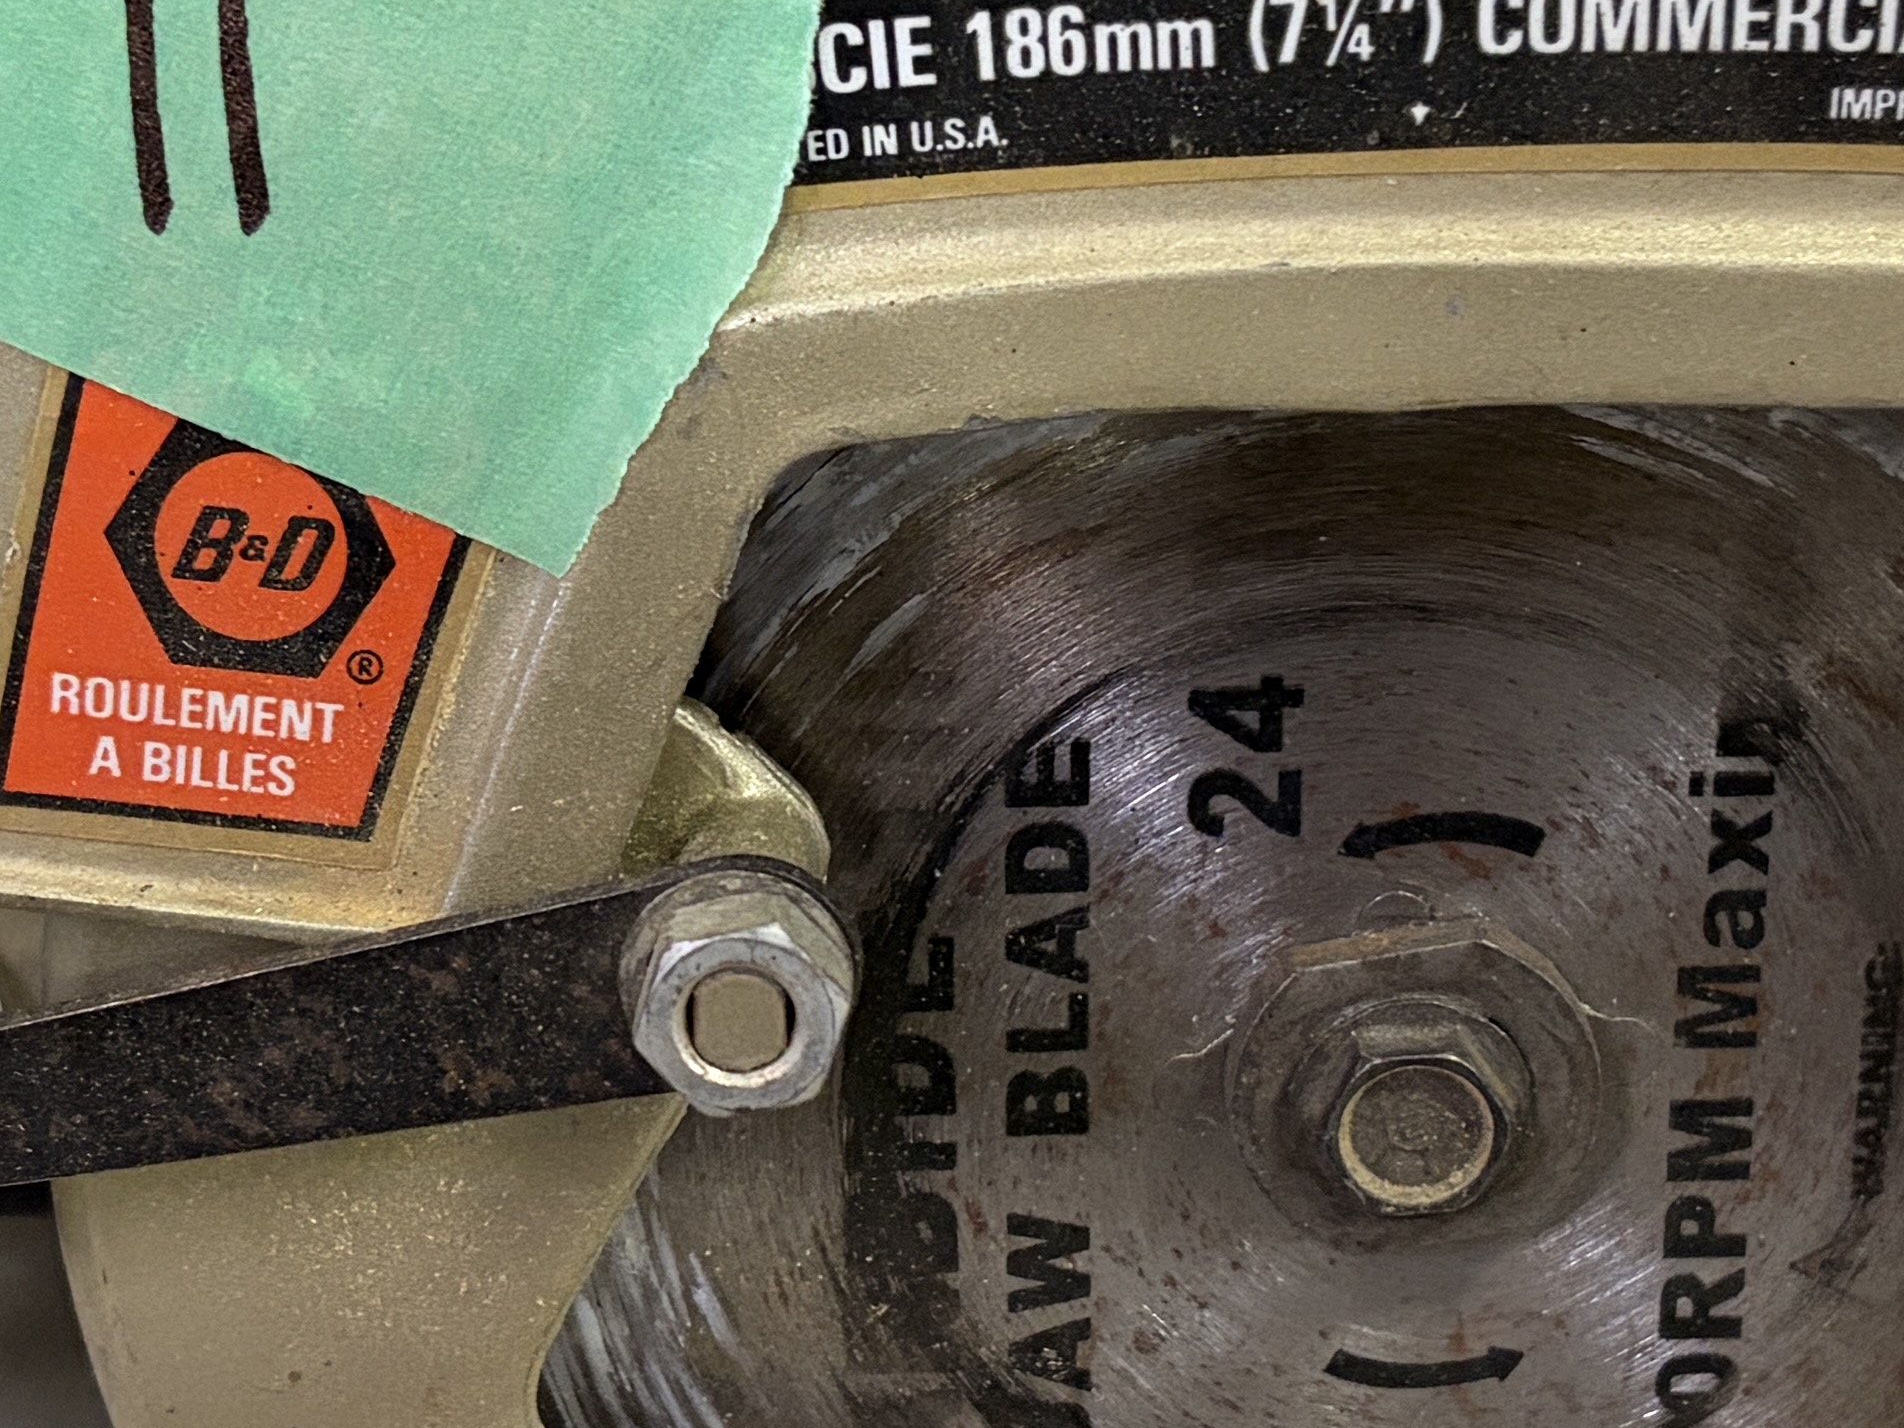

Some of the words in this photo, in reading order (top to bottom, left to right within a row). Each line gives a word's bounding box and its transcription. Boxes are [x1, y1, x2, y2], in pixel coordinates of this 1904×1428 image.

[808, 15, 938, 94] CIE
[966, 4, 1216, 83] 186mm
[802, 127, 850, 162] ED
[861, 123, 899, 157] IN
[910, 117, 1009, 153] U.S.A.
[170, 504, 337, 593] B&D
[49, 671, 345, 745] ROULEMENT
[88, 735, 122, 778] A
[142, 745, 297, 798] BILLES
[1187, 674, 1306, 840] 24
[1005, 735, 1093, 1139] BLADE
